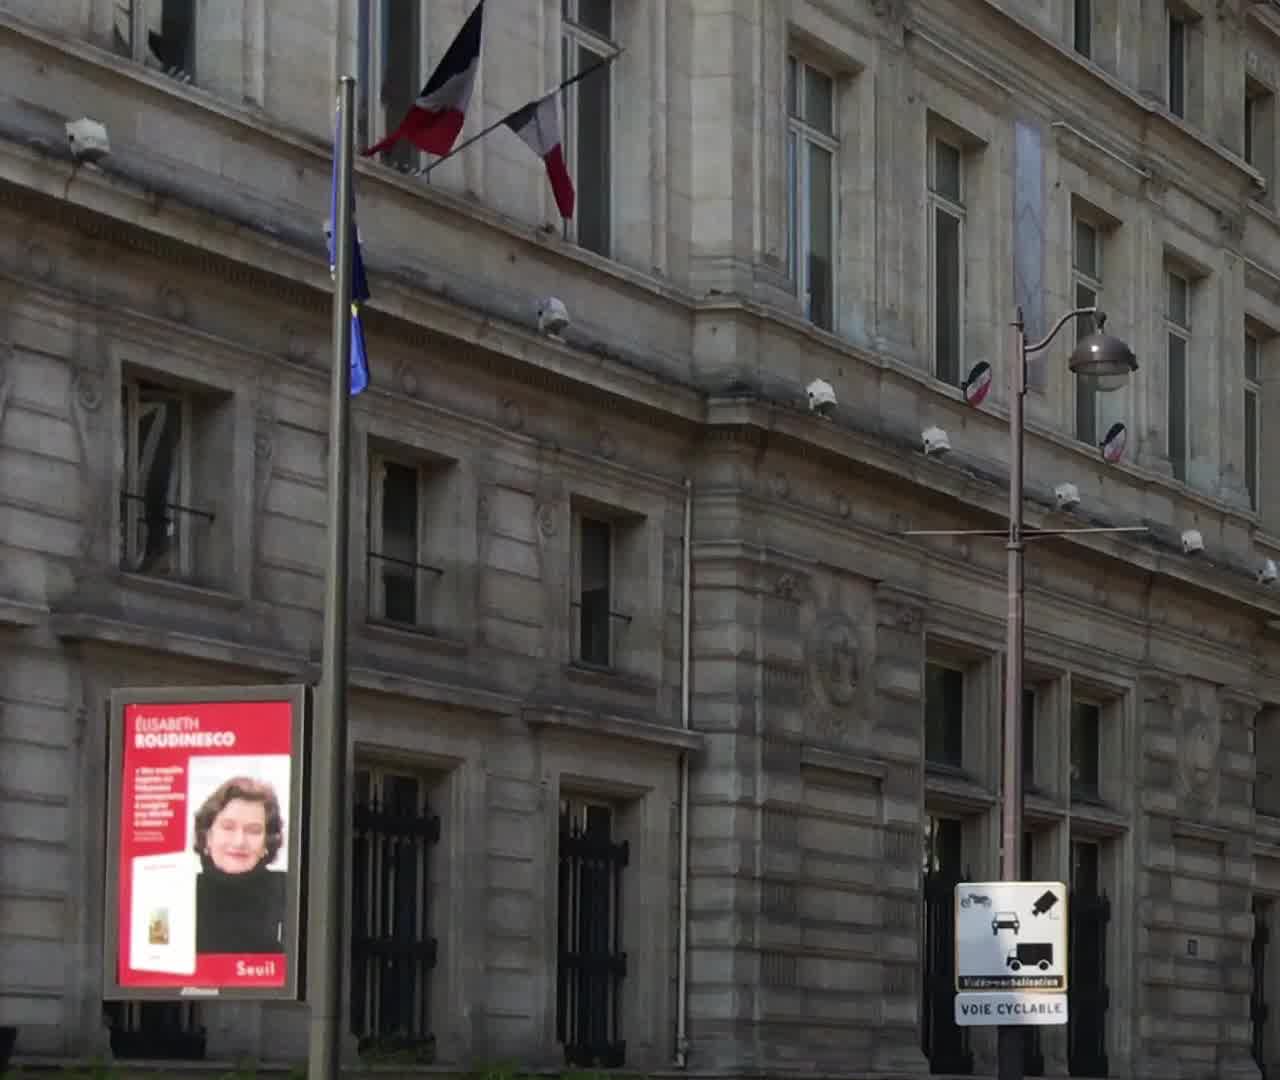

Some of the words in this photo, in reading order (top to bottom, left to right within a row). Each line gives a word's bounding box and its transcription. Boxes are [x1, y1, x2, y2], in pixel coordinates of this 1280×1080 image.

[236, 960, 276, 976] Seuil
[961, 1003, 992, 1015] VOIE
[997, 1003, 1064, 1015] CYCLABLE
